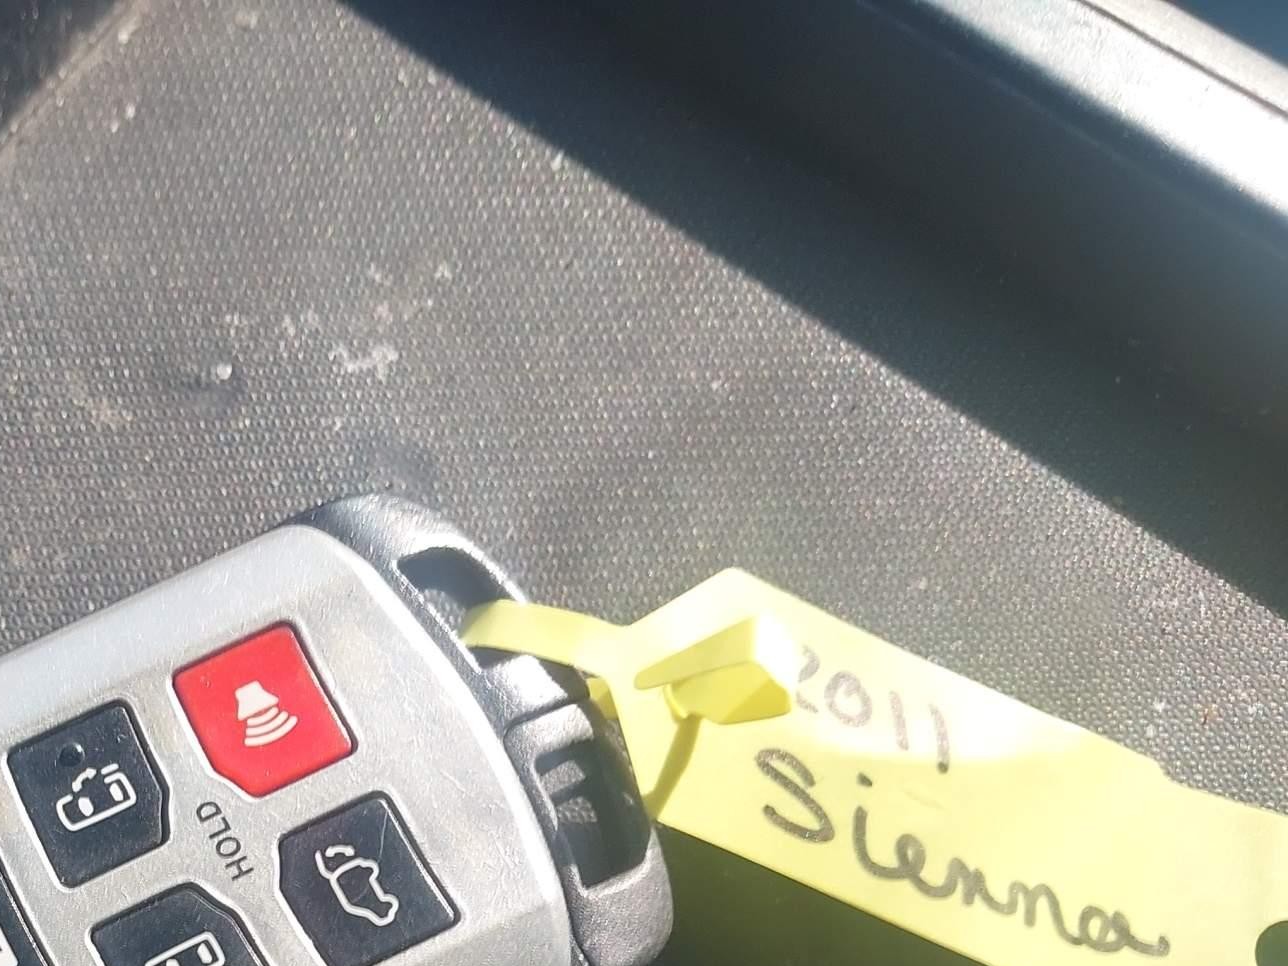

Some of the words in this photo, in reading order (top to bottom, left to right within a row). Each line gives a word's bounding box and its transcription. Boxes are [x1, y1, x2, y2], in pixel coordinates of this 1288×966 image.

[795, 645, 951, 774] 2011
[196, 801, 254, 881] HOLD
[755, 748, 1170, 958] Sienna
